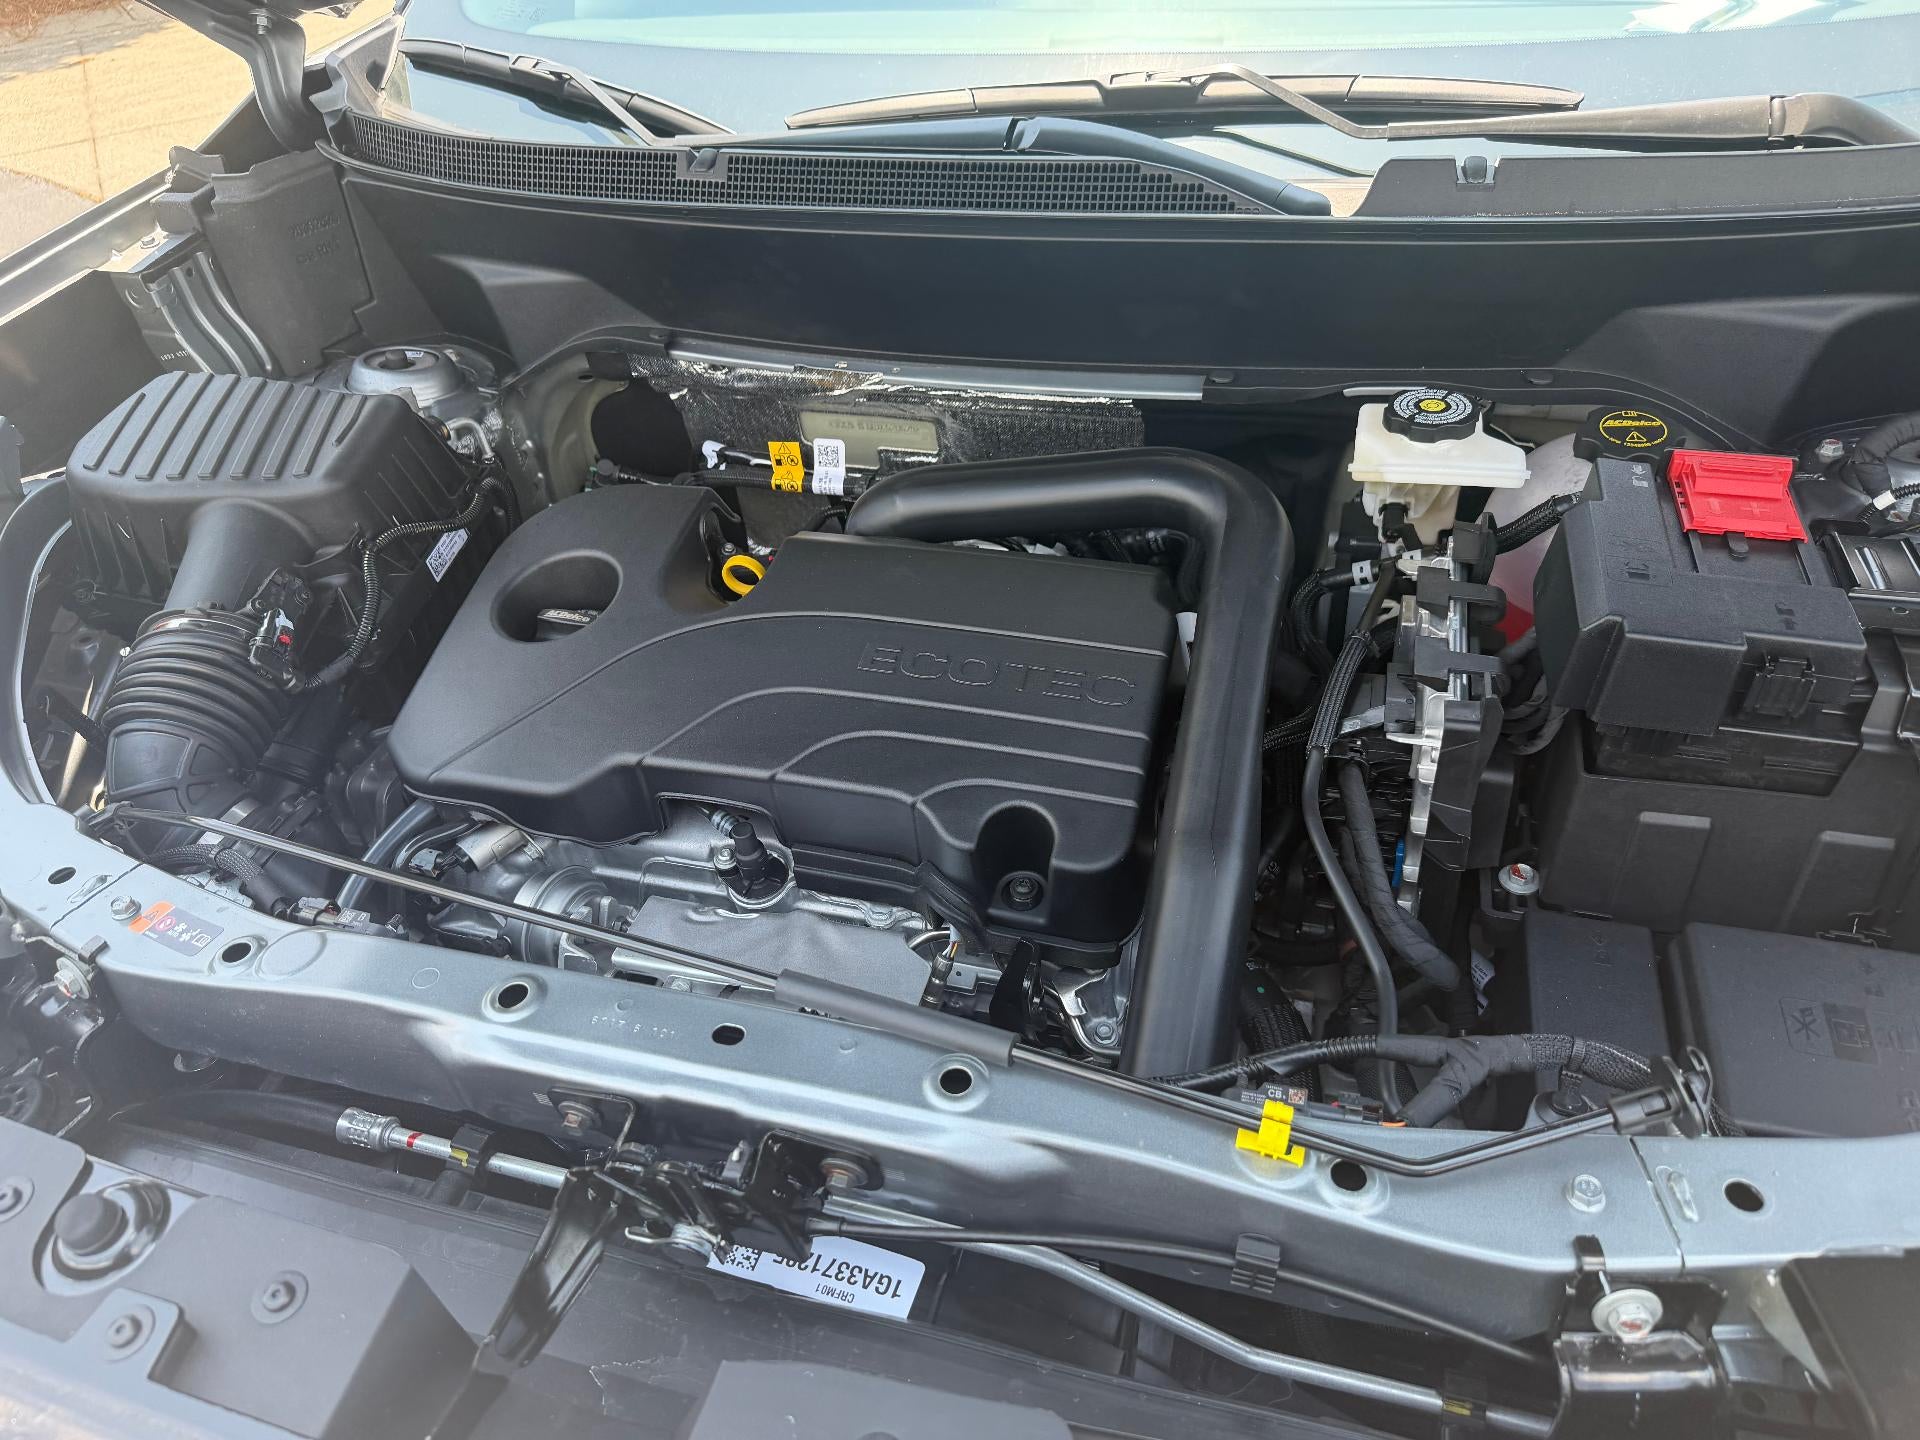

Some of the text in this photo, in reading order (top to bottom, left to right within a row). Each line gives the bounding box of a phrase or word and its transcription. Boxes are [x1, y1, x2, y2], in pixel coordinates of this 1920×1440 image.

[1602, 419, 1661, 427] ACDelco
[543, 609, 590, 622] ACDelco
[857, 644, 1136, 706] ECOTEC
[815, 1282, 855, 1304] CRFM01
